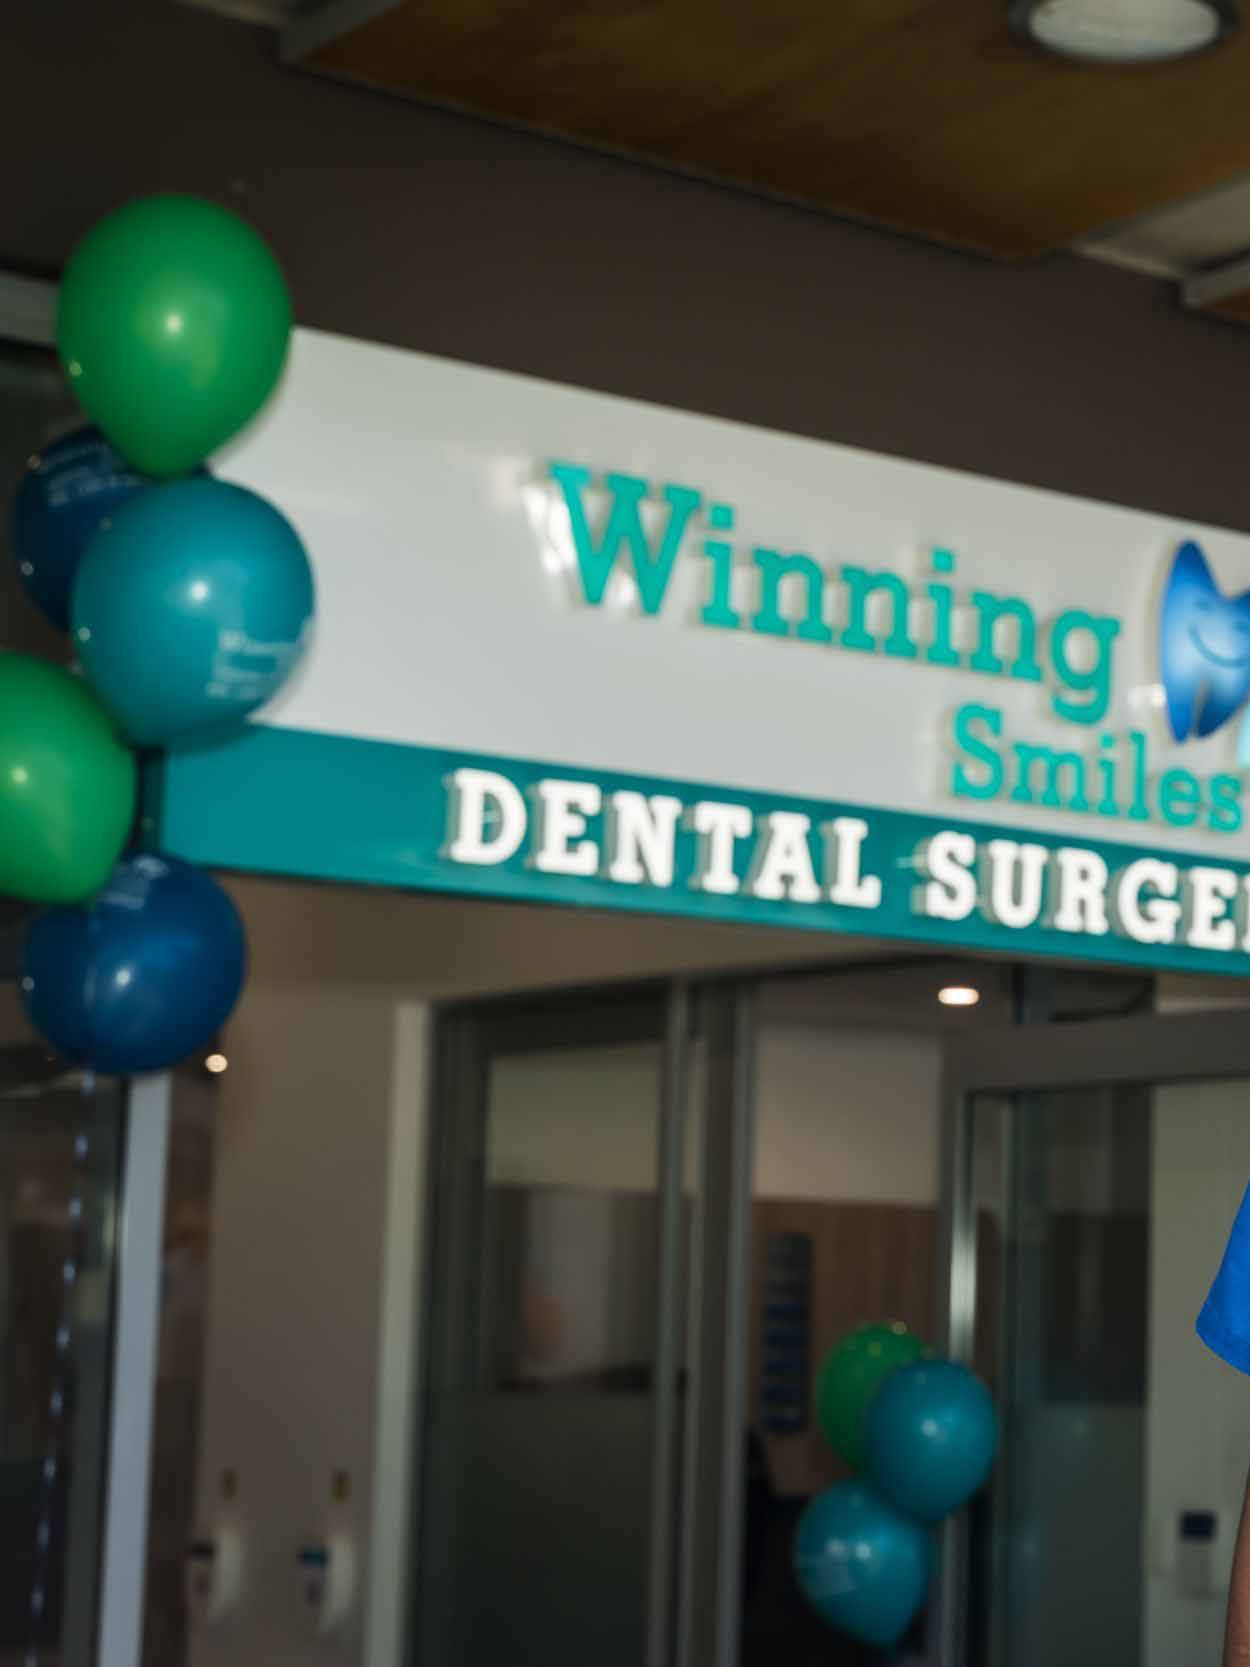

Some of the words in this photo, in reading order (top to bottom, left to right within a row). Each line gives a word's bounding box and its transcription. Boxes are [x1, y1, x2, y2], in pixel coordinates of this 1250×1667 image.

[548, 460, 1120, 726] Winning
[446, 767, 881, 908] DENTAL
[950, 702, 1245, 832] Smiles
